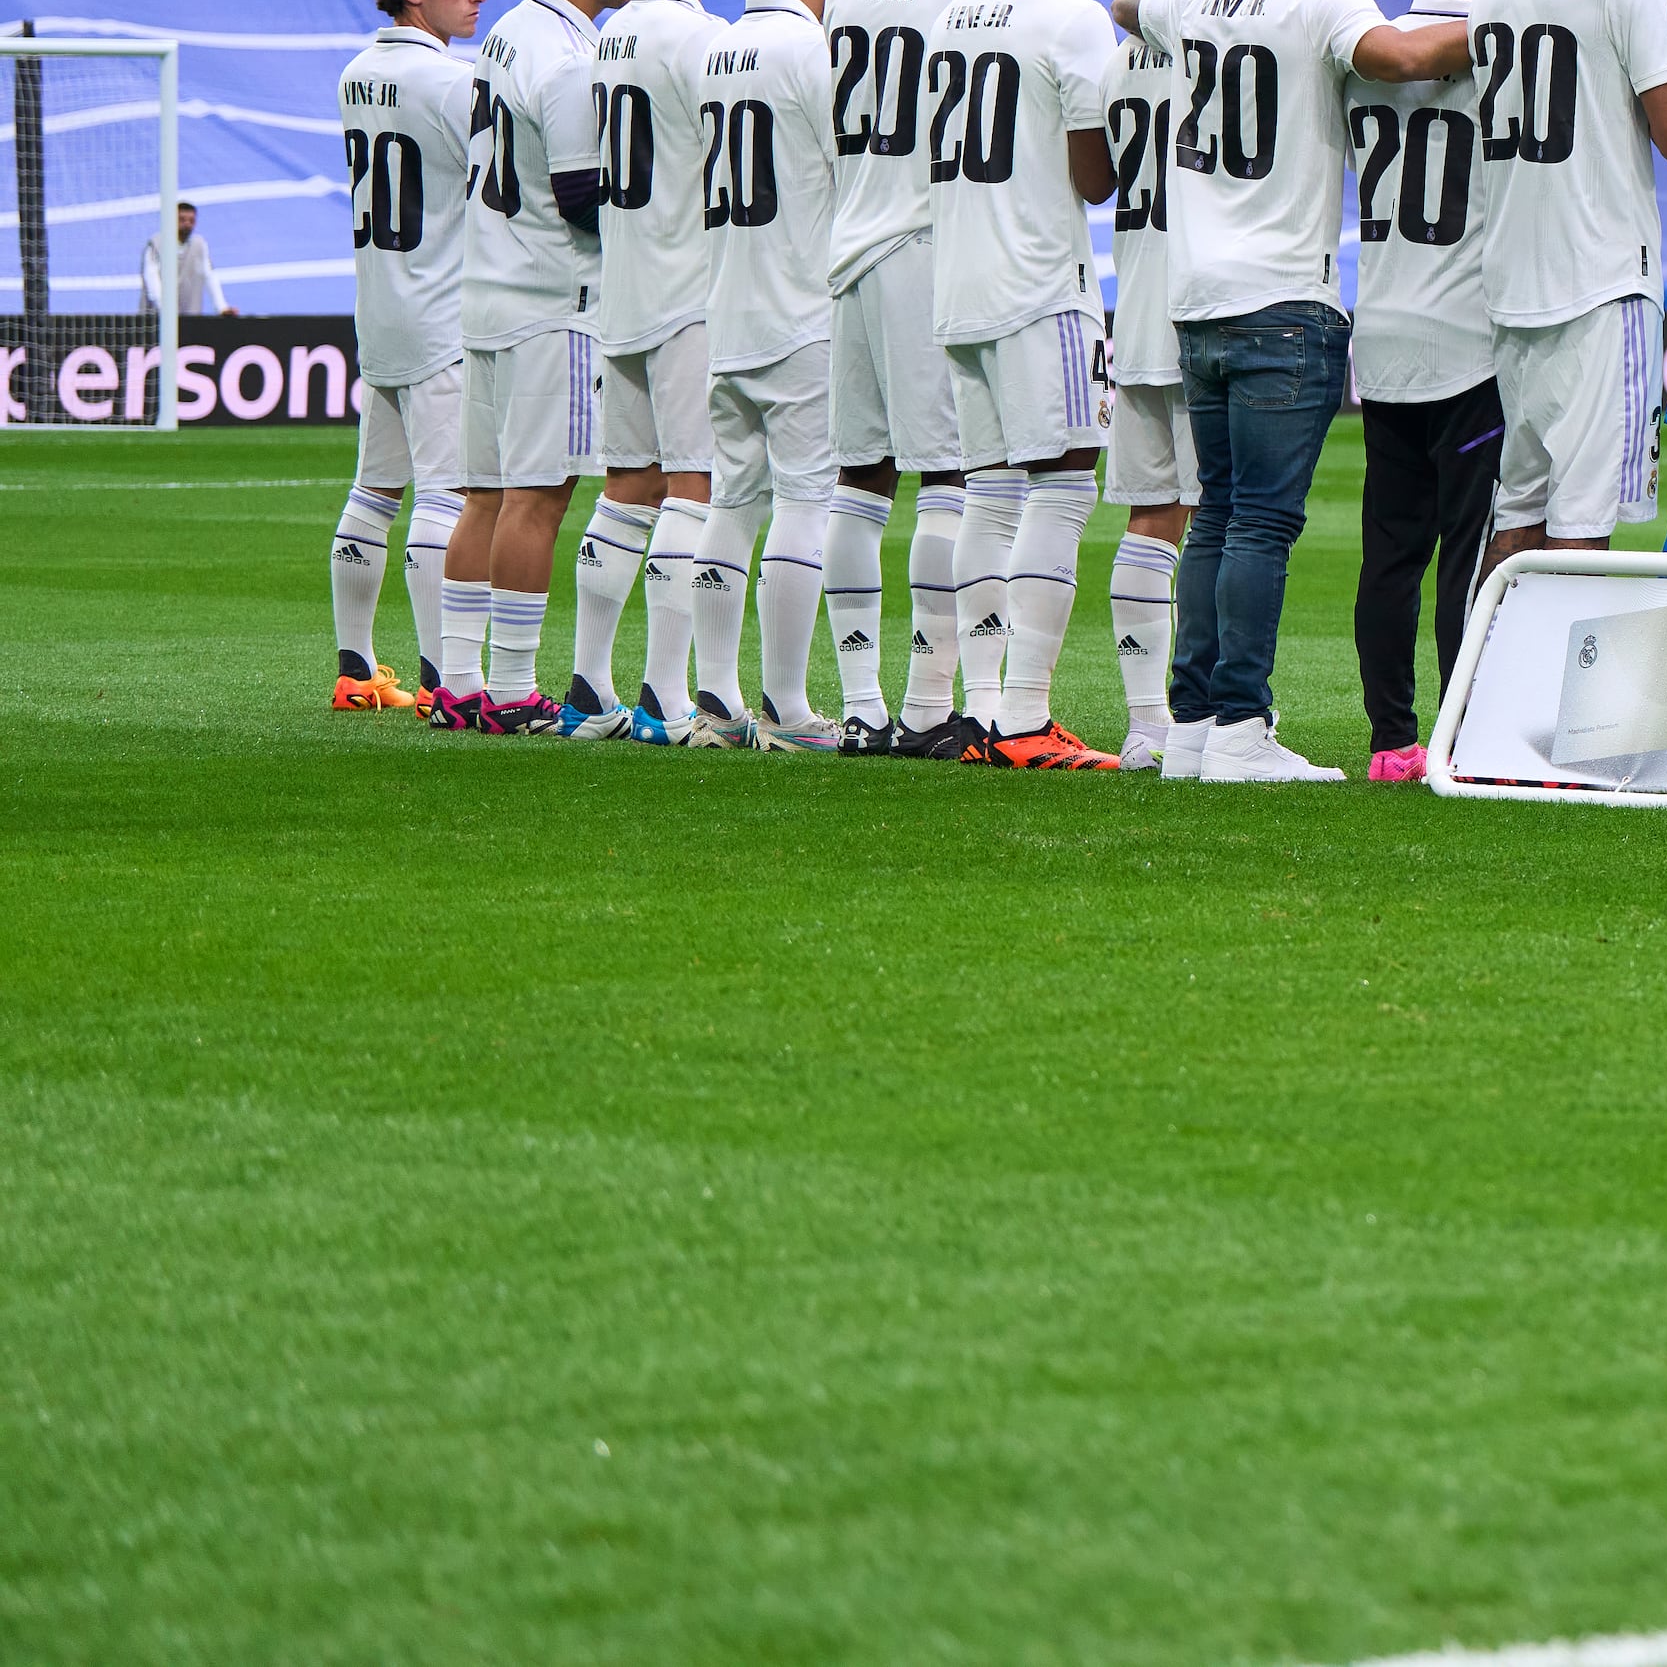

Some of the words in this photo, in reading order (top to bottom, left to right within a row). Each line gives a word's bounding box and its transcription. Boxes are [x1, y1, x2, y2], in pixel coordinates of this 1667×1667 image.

[948, 5, 983, 30] VINI
[983, 4, 1011, 28] JR.
[830, 26, 925, 157] 20
[929, 50, 1020, 184] 20
[1176, 39, 1278, 179] 20
[1474, 22, 1578, 164] 20
[704, 100, 778, 230] 20
[1349, 104, 1474, 246] 20
[839, 641, 874, 652] adidas
